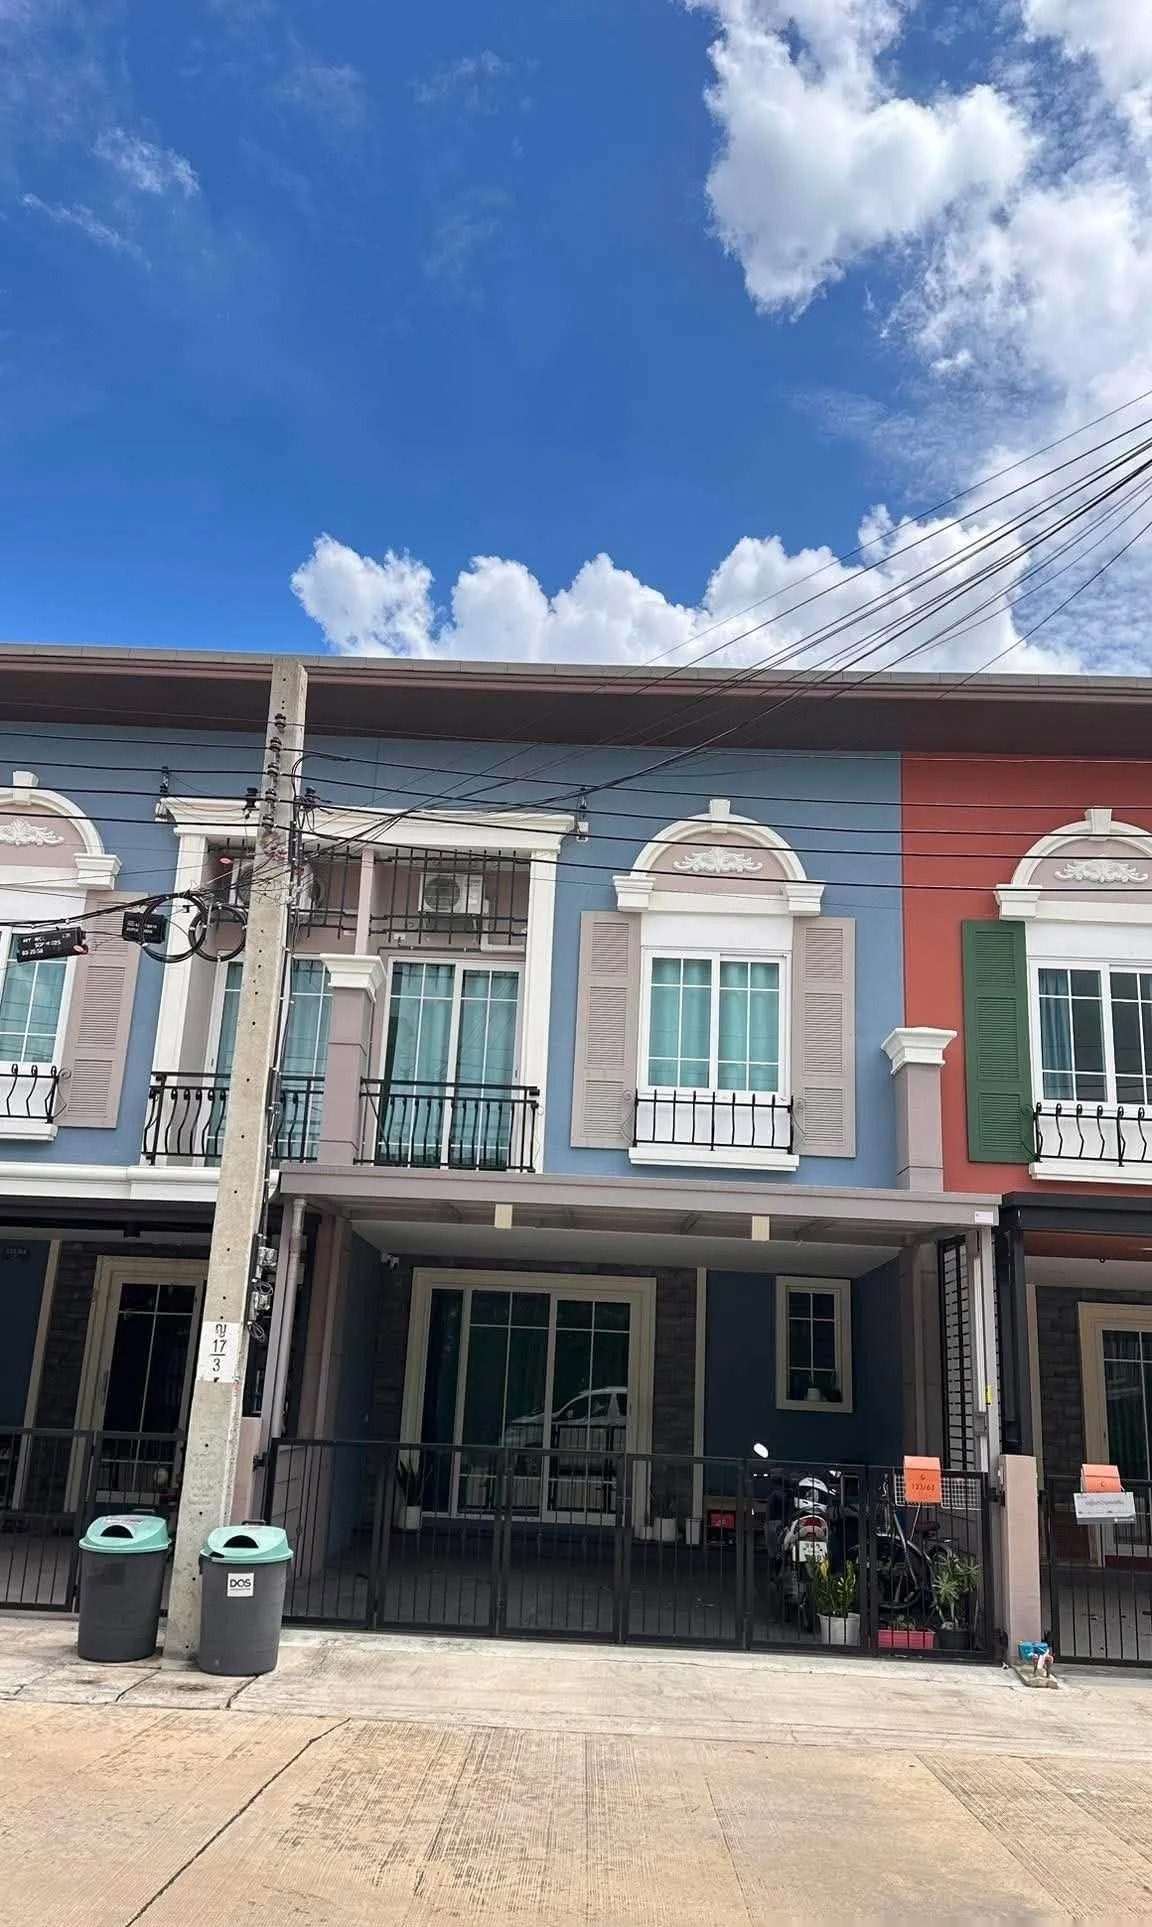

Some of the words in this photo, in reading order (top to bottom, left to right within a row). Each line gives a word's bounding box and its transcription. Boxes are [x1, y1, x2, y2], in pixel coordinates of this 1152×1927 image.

[212, 1339, 227, 1353] 17
[212, 1358, 221, 1372] 3
[229, 1578, 252, 1588] DOS
